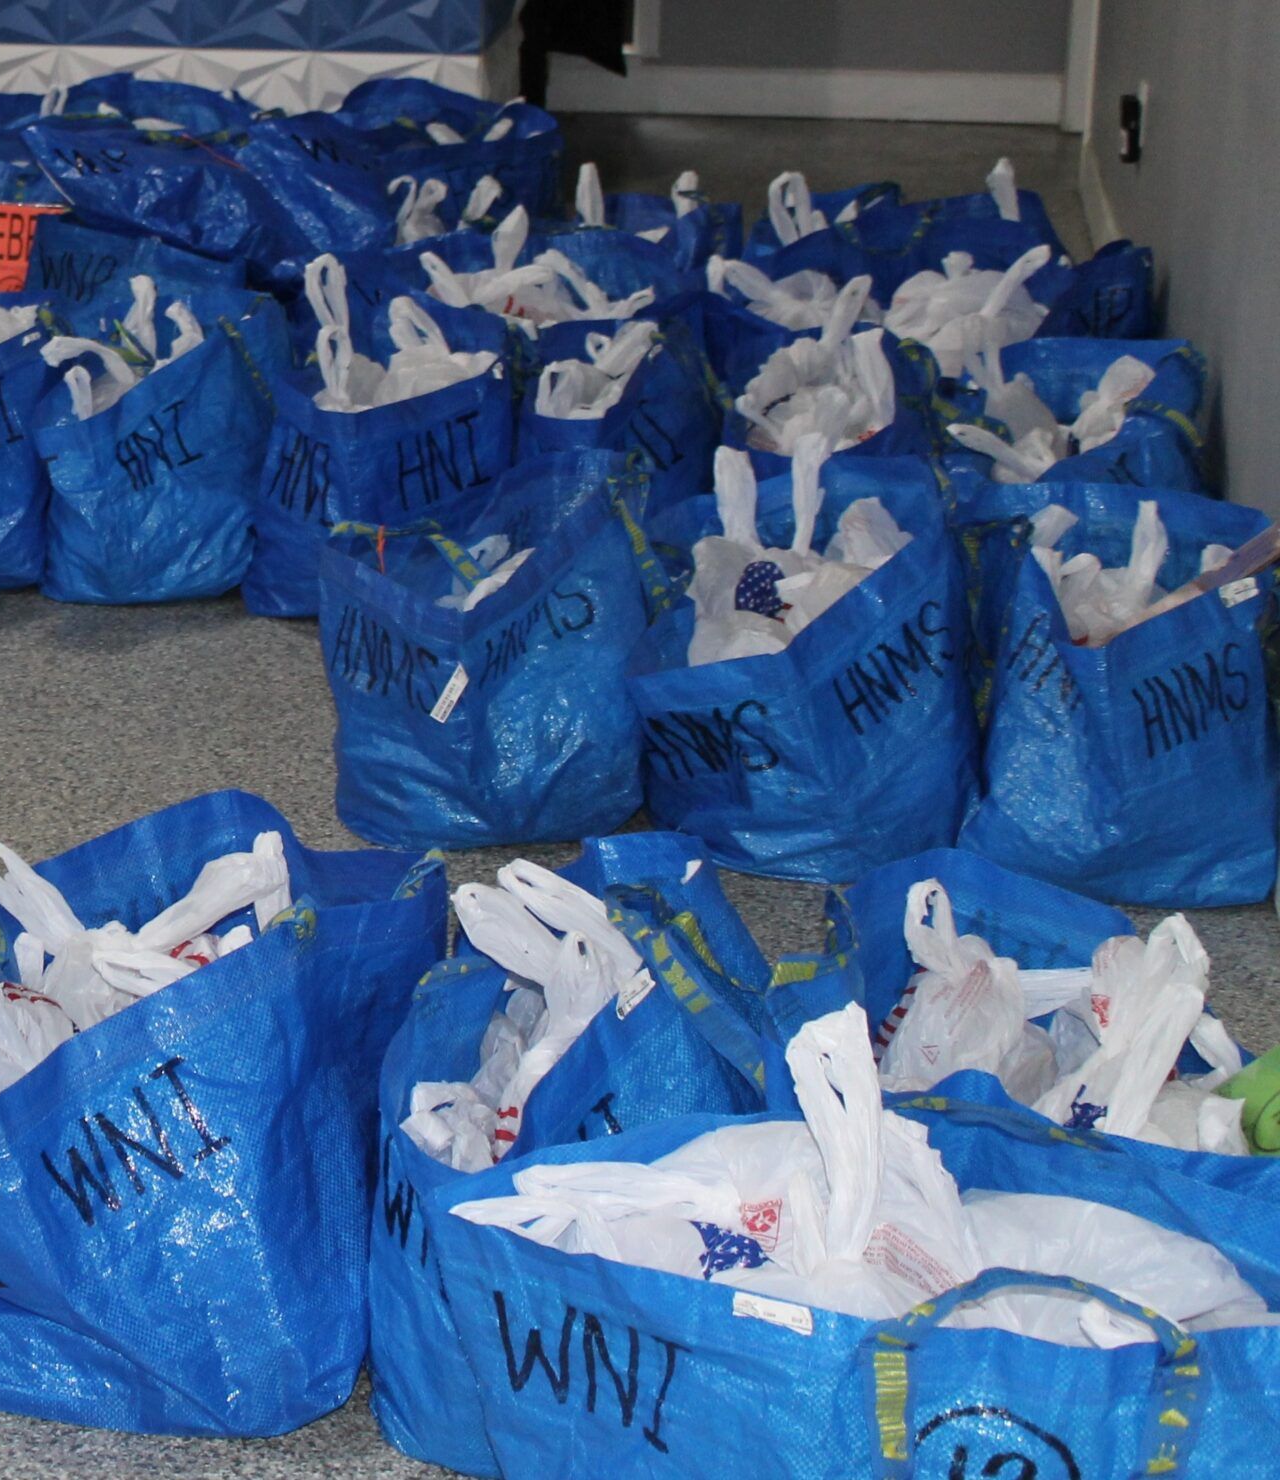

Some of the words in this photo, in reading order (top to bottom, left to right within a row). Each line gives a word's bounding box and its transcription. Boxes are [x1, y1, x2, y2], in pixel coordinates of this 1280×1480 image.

[114, 399, 205, 492] HNI
[395, 409, 494, 513] HNI
[833, 600, 956, 737] HNMS
[1132, 642, 1251, 759] HNMS
[40, 1054, 232, 1228] WNI
[491, 1289, 692, 1454] WNI
